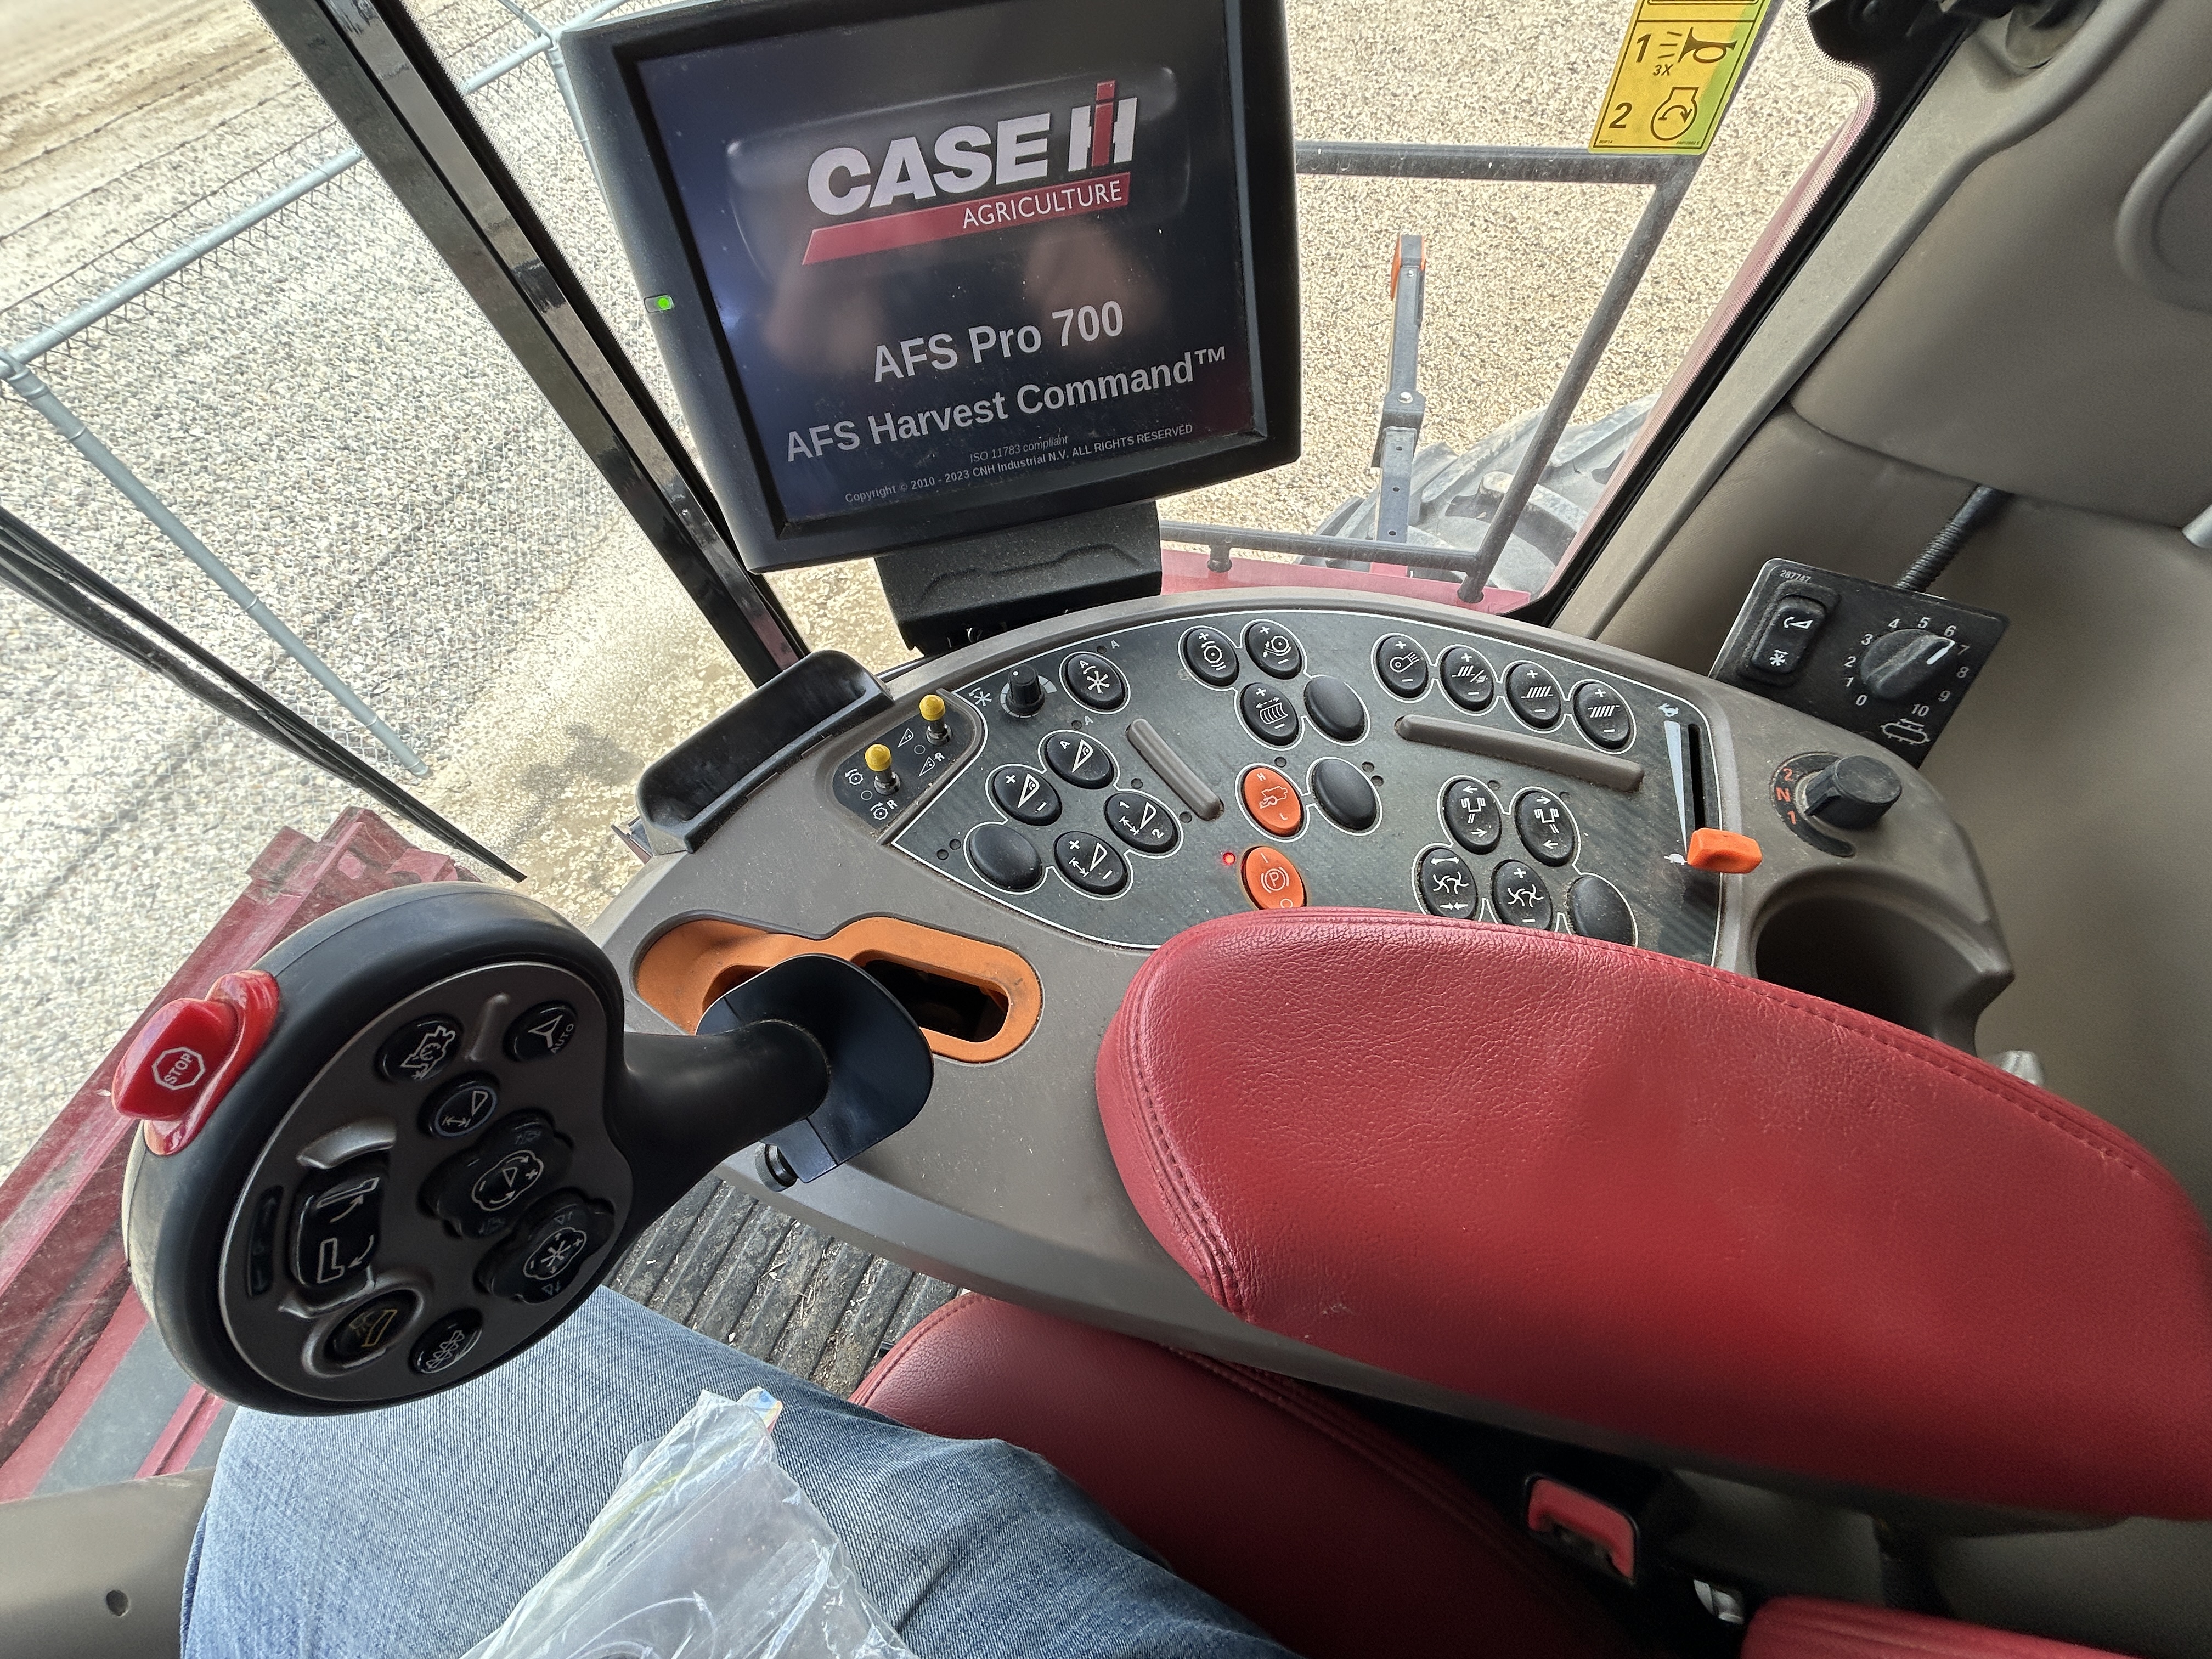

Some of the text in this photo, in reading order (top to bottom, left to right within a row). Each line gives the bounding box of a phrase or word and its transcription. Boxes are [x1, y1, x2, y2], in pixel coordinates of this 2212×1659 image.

[1635, 33, 1652, 63] 1
[1652, 64, 1673, 76] 3X
[1609, 102, 1633, 128] 2
[807, 112, 1051, 216] CASE
[962, 180, 1122, 229] AGRICULTURE
[874, 301, 1124, 383] AFS Pro 700
[787, 420, 861, 462] AFS
[868, 391, 1008, 445] Harvest
[969, 435, 1068, 463] ISO 11783 compliant
[845, 484, 897, 503] Copyright
[910, 476, 935, 490] 2010
[944, 470, 970, 483] 2023
[972, 463, 996, 478] CNH
[997, 454, 1046, 473] Industrial
[1048, 449, 1069, 462] N.V.
[1071, 446, 1093, 458] ALL
[1094, 435, 1135, 453] RIGHTS
[1137, 424, 1193, 444] RESERVED
[1888, 618, 1900, 629] 4
[1917, 617, 1931, 629] 5
[1944, 625, 1957, 637] 6
[1110, 640, 1120, 649] A
[1861, 633, 1874, 645] 3
[1957, 644, 1971, 656] 7
[1079, 659, 1089, 669] A
[1843, 656, 1857, 668] 2
[1956, 666, 1970, 679] 8
[1846, 676, 1854, 687] 1
[1855, 695, 1868, 706] 0
[1938, 690, 1951, 702] 9
[1911, 703, 1931, 717] 10
[1084, 715, 1094, 726] A
[1059, 740, 1071, 750] A
[934, 752, 945, 762] R
[1256, 772, 1266, 781] H
[1782, 768, 1794, 781] 2
[1775, 787, 1791, 802] N
[886, 799, 898, 810] R
[1279, 812, 1289, 821] L
[1787, 810, 1797, 825] 1
[1152, 828, 1164, 839] 2
[1269, 871, 1279, 887] P
[550, 1023, 574, 1054] AUTO
[164, 1053, 193, 1084] STOP
